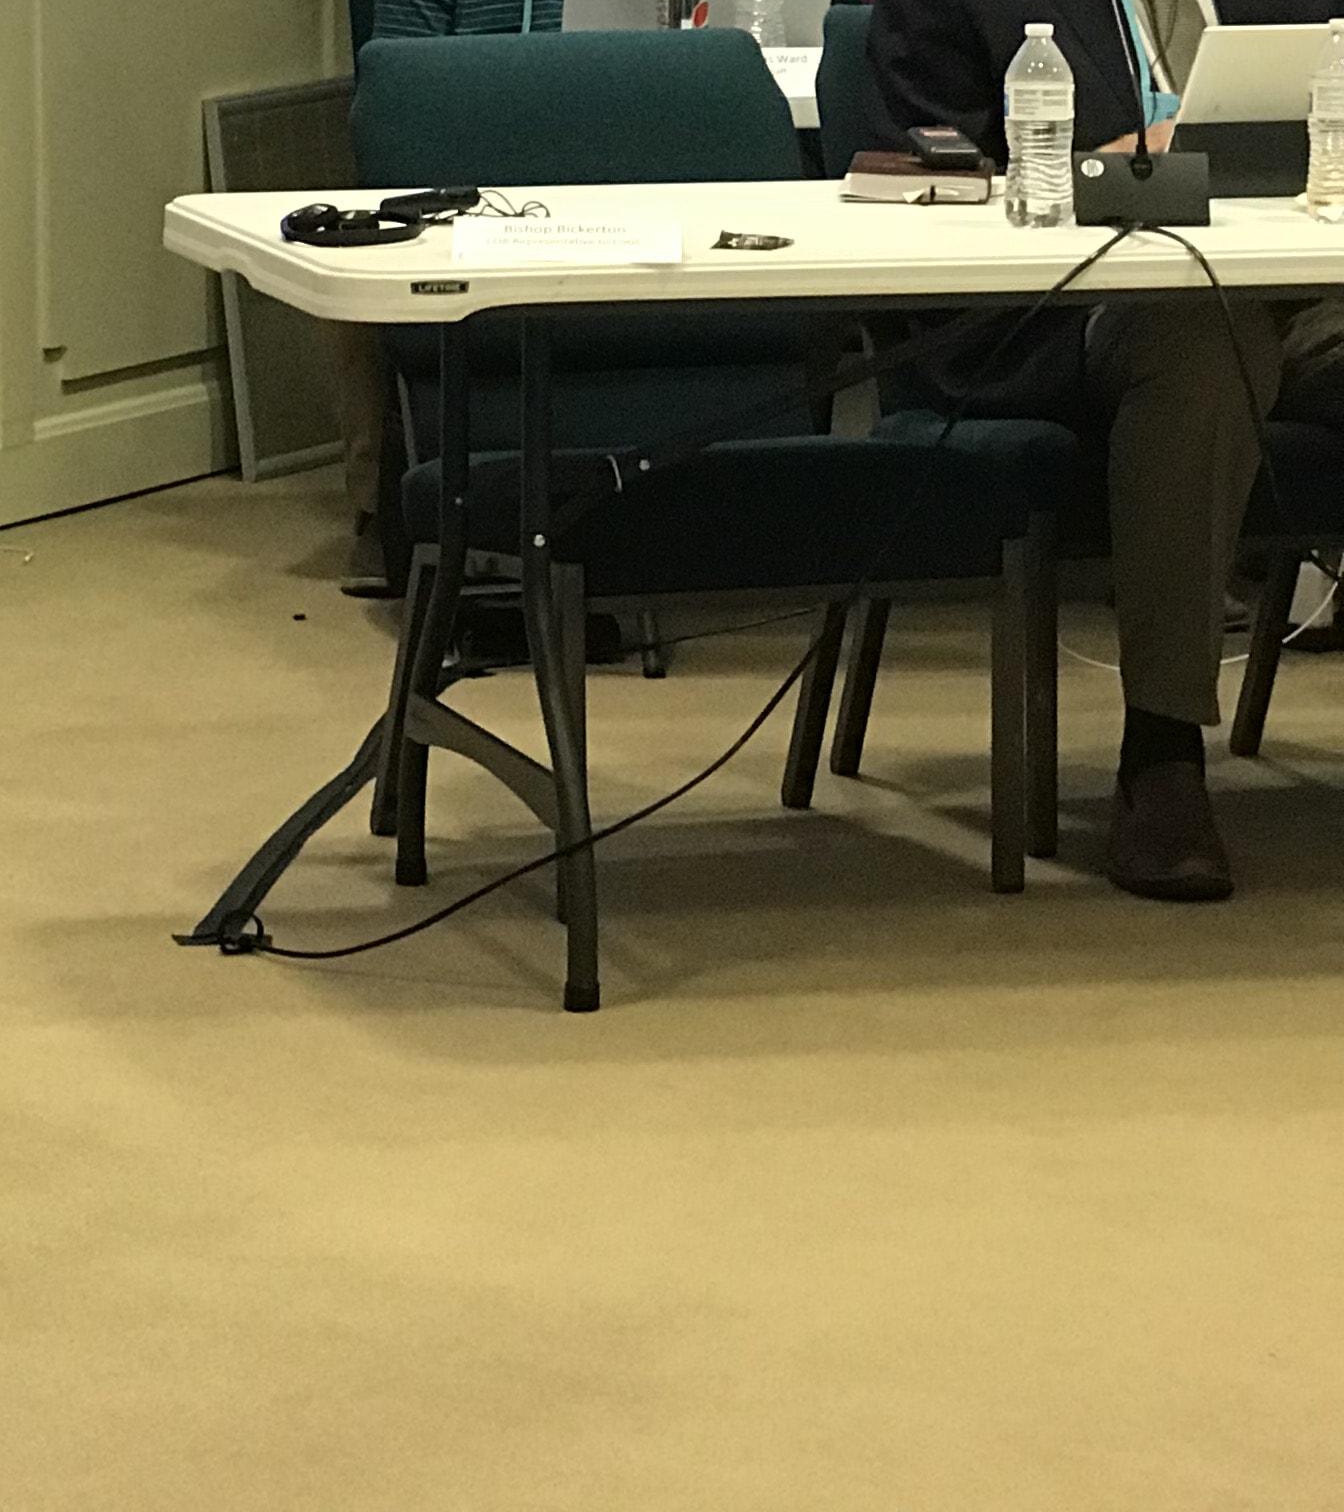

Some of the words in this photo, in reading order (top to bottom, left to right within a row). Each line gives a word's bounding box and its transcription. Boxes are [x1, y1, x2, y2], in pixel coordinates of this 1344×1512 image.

[776, 54, 808, 64] Ward
[504, 224, 552, 235] Bishop
[557, 224, 627, 235] Bickerton
